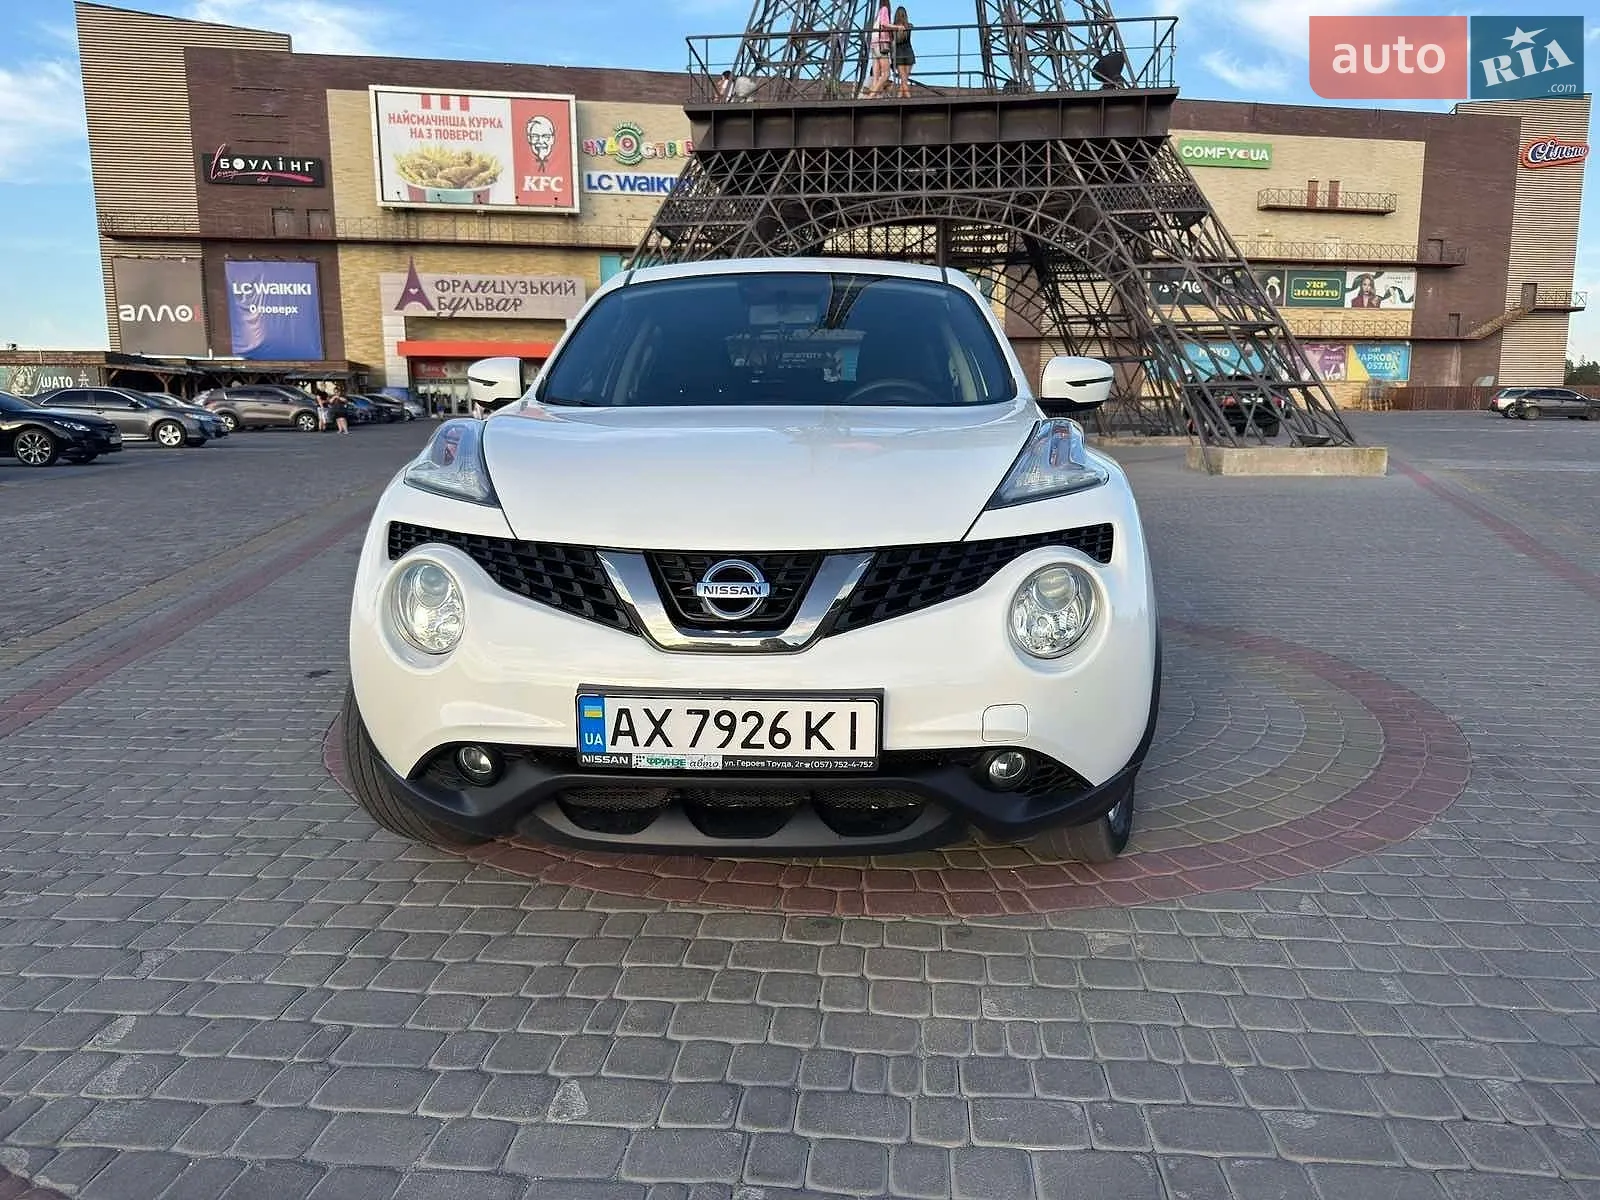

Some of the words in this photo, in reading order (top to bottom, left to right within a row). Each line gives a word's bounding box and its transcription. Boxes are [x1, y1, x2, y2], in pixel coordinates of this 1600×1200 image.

[388, 110, 466, 127] НАЙСМАЧНІША
[468, 115, 503, 129] КУРКА
[410, 128, 424, 139] НА
[435, 128, 483, 141] ПОВЕРСІ!
[1182, 145, 1238, 160] COMFY
[523, 175, 563, 192] KFC
[586, 174, 613, 192] LC
[232, 283, 252, 295] LC
[435, 279, 576, 297] ФРАНЦУЗЬКИЙ
[1305, 281, 1328, 289] УКР
[1293, 288, 1339, 297] ЗОЛОТО
[258, 304, 299, 315] поверх
[703, 585, 761, 595] NISSAN
[584, 733, 604, 745] UA
[610, 708, 673, 748] AX
[686, 709, 792, 750] 7926
[805, 710, 857, 751] KI
[582, 754, 629, 764] NISSAN
[646, 757, 687, 767] ФРУНЗЕ
